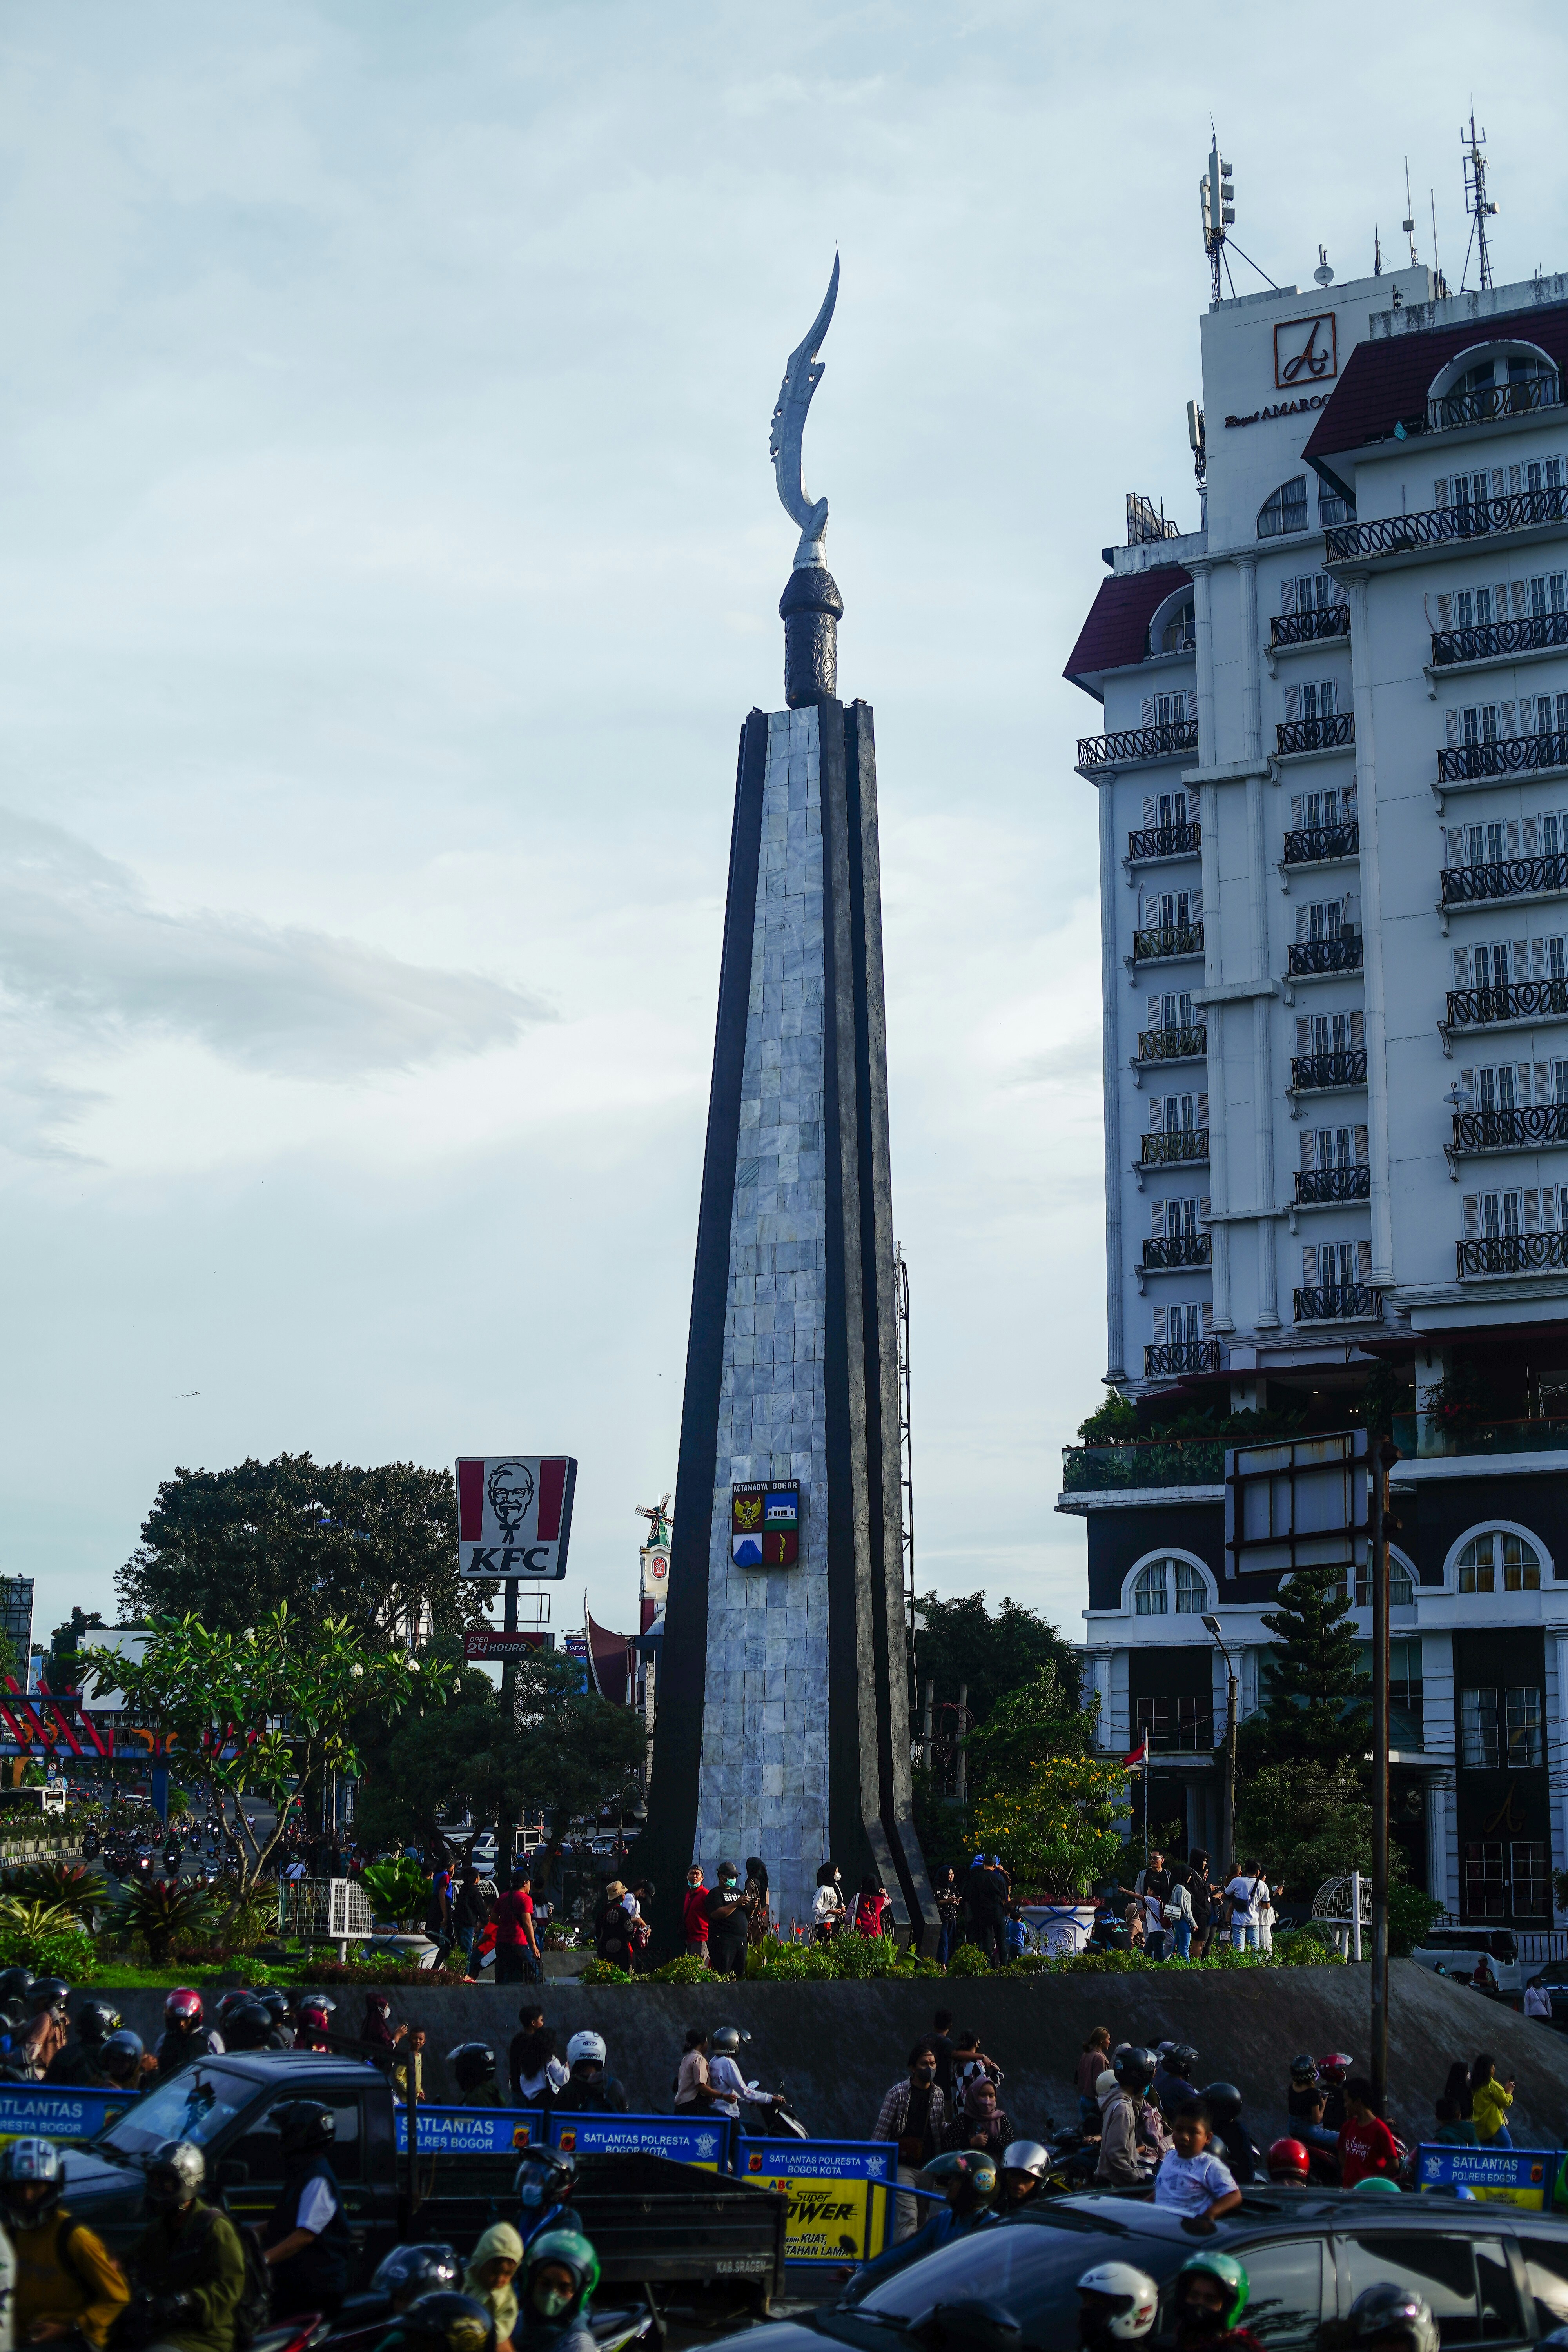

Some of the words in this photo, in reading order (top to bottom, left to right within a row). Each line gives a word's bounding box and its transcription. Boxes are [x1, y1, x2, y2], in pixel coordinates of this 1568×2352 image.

[1283, 320, 1328, 380] A
[1261, 393, 1332, 420] AMAROO
[733, 1483, 768, 1492] KOTAMADYA
[467, 1547, 549, 1572] KFC
[467, 1643, 487, 1654] 24
[489, 1643, 526, 1652] HOURS
[1483, 1778, 1526, 1832] A
[40, 2122, 81, 2133] BOGOR
[401, 2116, 494, 2135] SATLANTAS
[400, 2135, 447, 2148] PLRES
[451, 2138, 493, 2149] BOGOR
[584, 2134, 639, 2144] SATLANTAS
[641, 2135, 690, 2146] POLRESTA
[642, 2147, 667, 2156] KOTA
[769, 2155, 817, 2164] SATLANTAS
[819, 2156, 861, 2166] POLRESTA
[1452, 2156, 1518, 2171] SATLANTAS
[788, 2165, 818, 2174] BOGOR
[820, 2167, 842, 2175] KOTA
[1452, 2172, 1485, 2181] POLRES
[1488, 2174, 1517, 2183] BOGOR
[768, 2180, 794, 2190] ABC
[797, 2191, 832, 2203] Super
[787, 2202, 859, 2225] OWER
[800, 2233, 827, 2246] KUAT,
[786, 2245, 818, 2256] TAHAN
